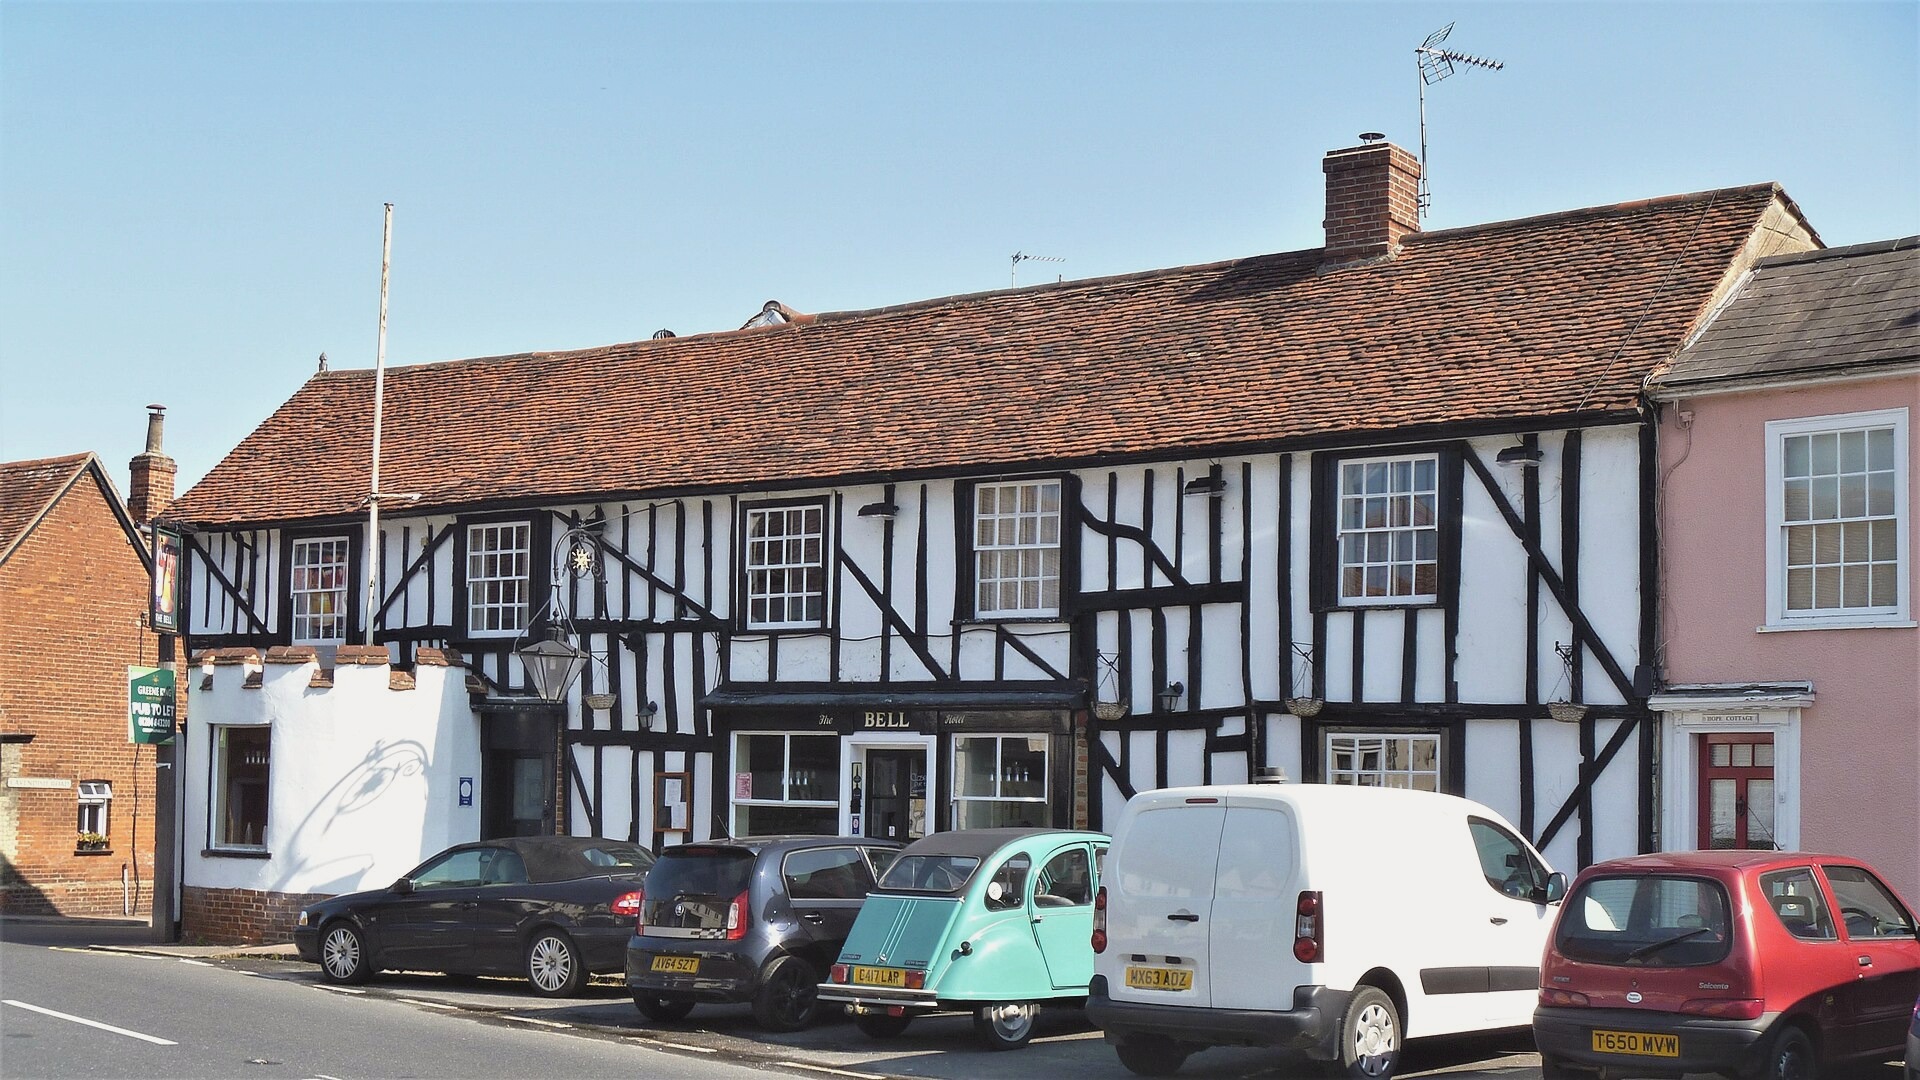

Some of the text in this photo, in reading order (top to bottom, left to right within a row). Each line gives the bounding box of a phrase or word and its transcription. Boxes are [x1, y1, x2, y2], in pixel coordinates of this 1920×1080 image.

[163, 614, 172, 625] BELL
[137, 685, 159, 696] GREENE
[132, 701, 175, 717] PUB TO LET
[818, 711, 965, 728] The BELL Hotel
[654, 957, 696, 971] AV64 SZT
[881, 970, 900, 984] LAR
[1130, 969, 1187, 987] MX63 AOZ
[1594, 1032, 1677, 1054] T650 MVW
